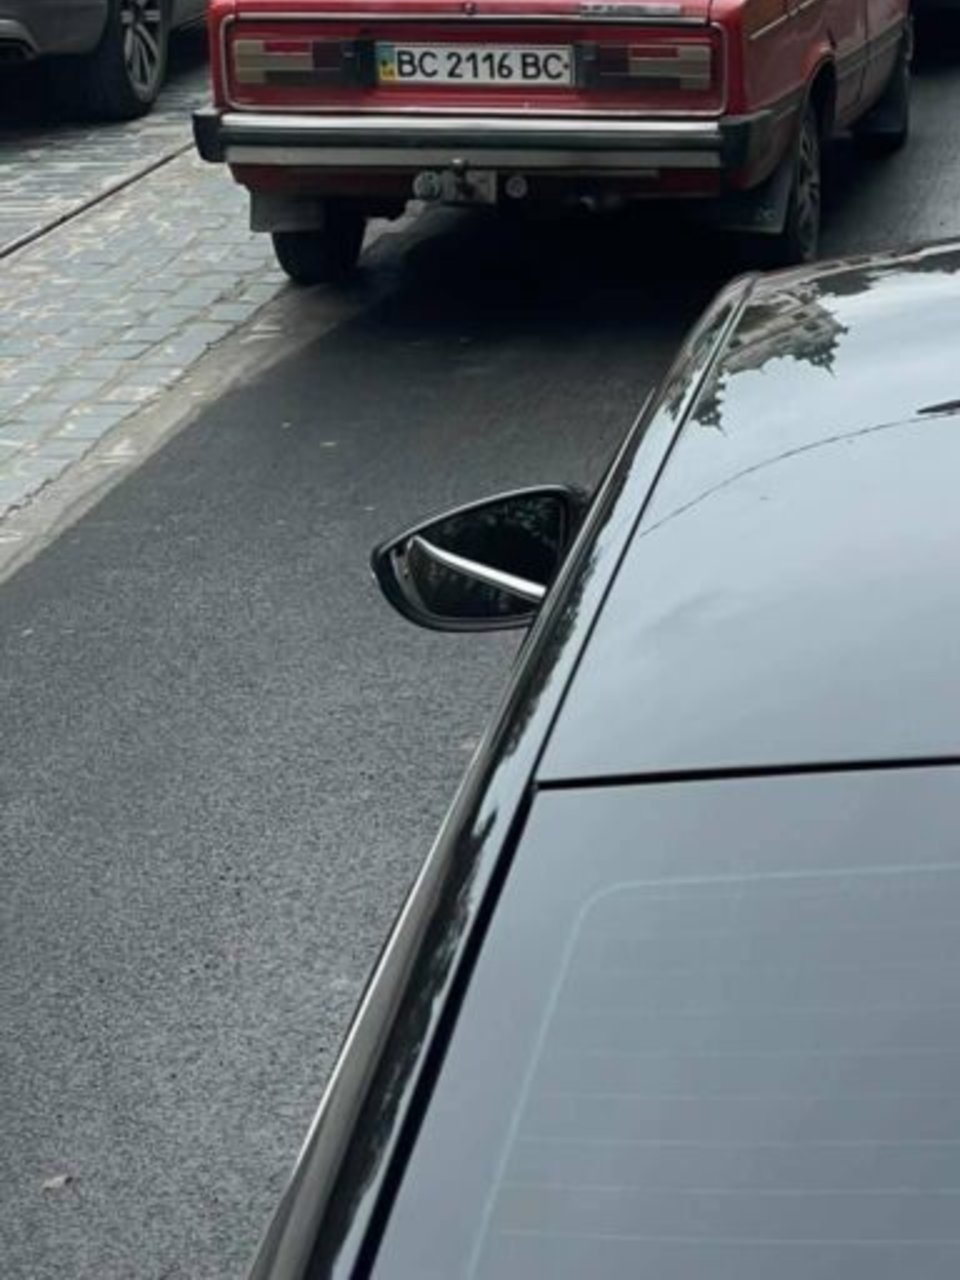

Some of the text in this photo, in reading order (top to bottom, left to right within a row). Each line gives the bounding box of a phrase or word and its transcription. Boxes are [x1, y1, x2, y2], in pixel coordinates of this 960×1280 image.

[397, 50, 563, 80] BC 2116 BC
